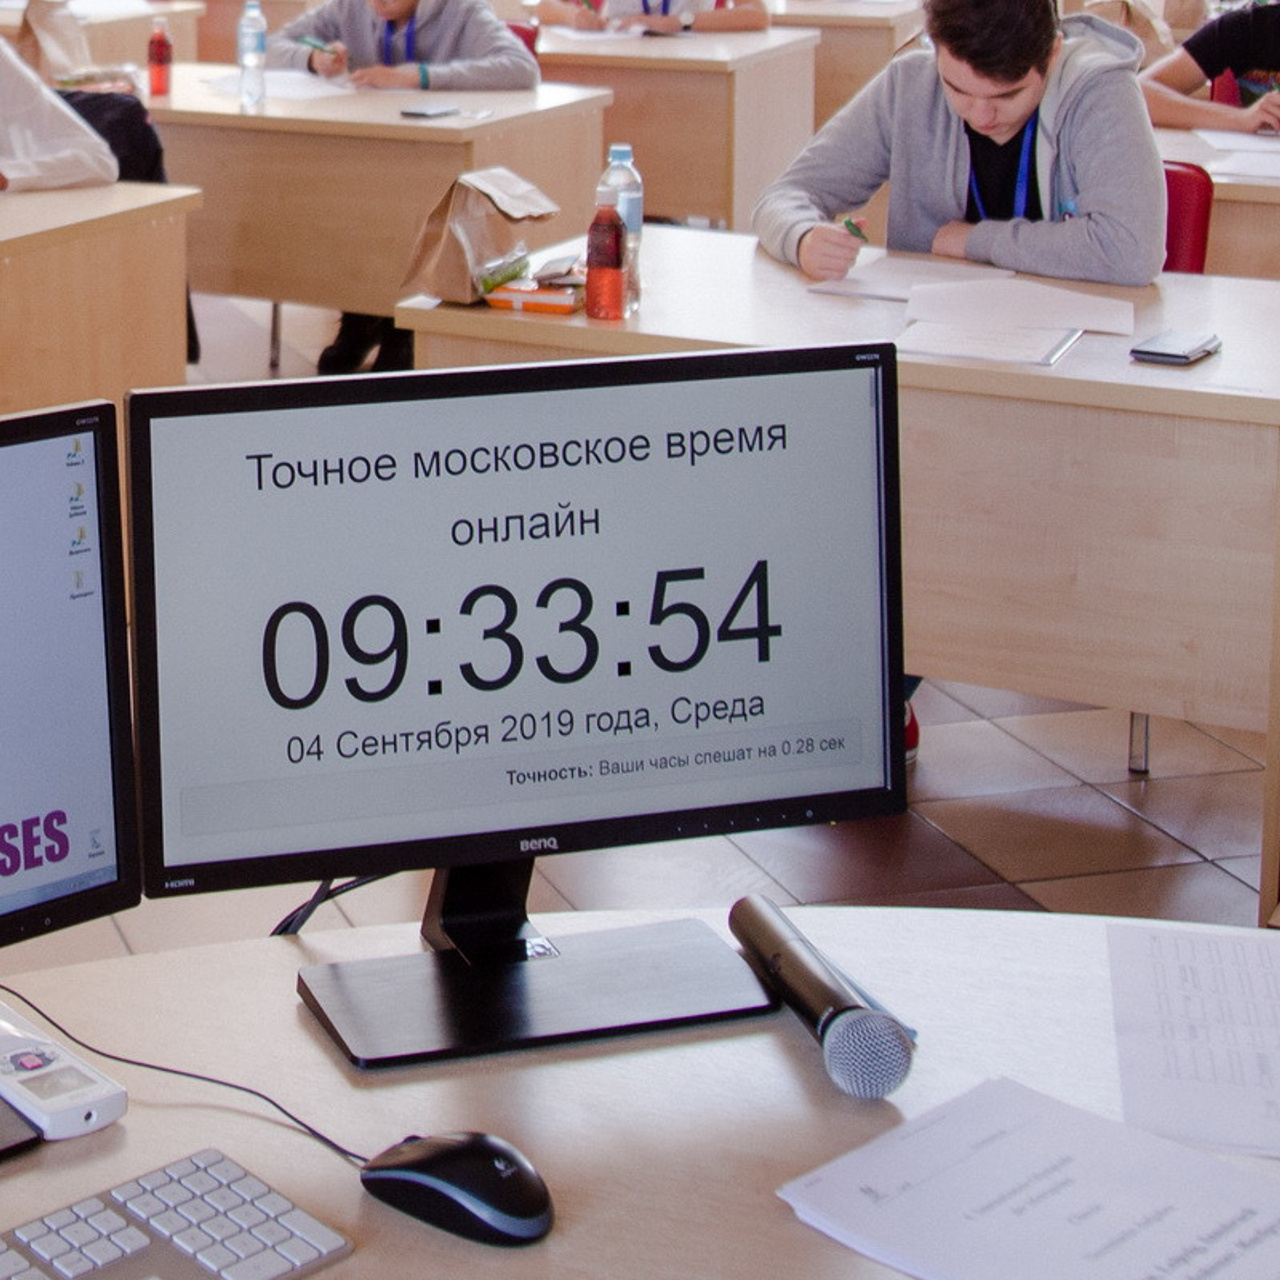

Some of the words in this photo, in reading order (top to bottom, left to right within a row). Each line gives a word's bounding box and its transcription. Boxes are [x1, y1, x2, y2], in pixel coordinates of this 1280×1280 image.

[246, 452, 397, 491] Точное
[413, 434, 651, 478] московское
[666, 424, 788, 465] время
[451, 502, 600, 547] онлайн
[262, 560, 782, 710] 09:33:54
[287, 734, 324, 763] 04
[336, 720, 490, 760] Сентября
[501, 709, 575, 742] 2019
[585, 706, 659, 734] года,
[670, 695, 765, 730] Среда
[506, 765, 594, 786] Точность:
[599, 759, 645, 776] Ваши
[649, 753, 689, 769] часы
[694, 747, 753, 765] спешат
[758, 745, 777, 758] на
[781, 738, 815, 755] 0.28
[819, 735, 846, 751] сек
[519, 835, 559, 852] BenQ
